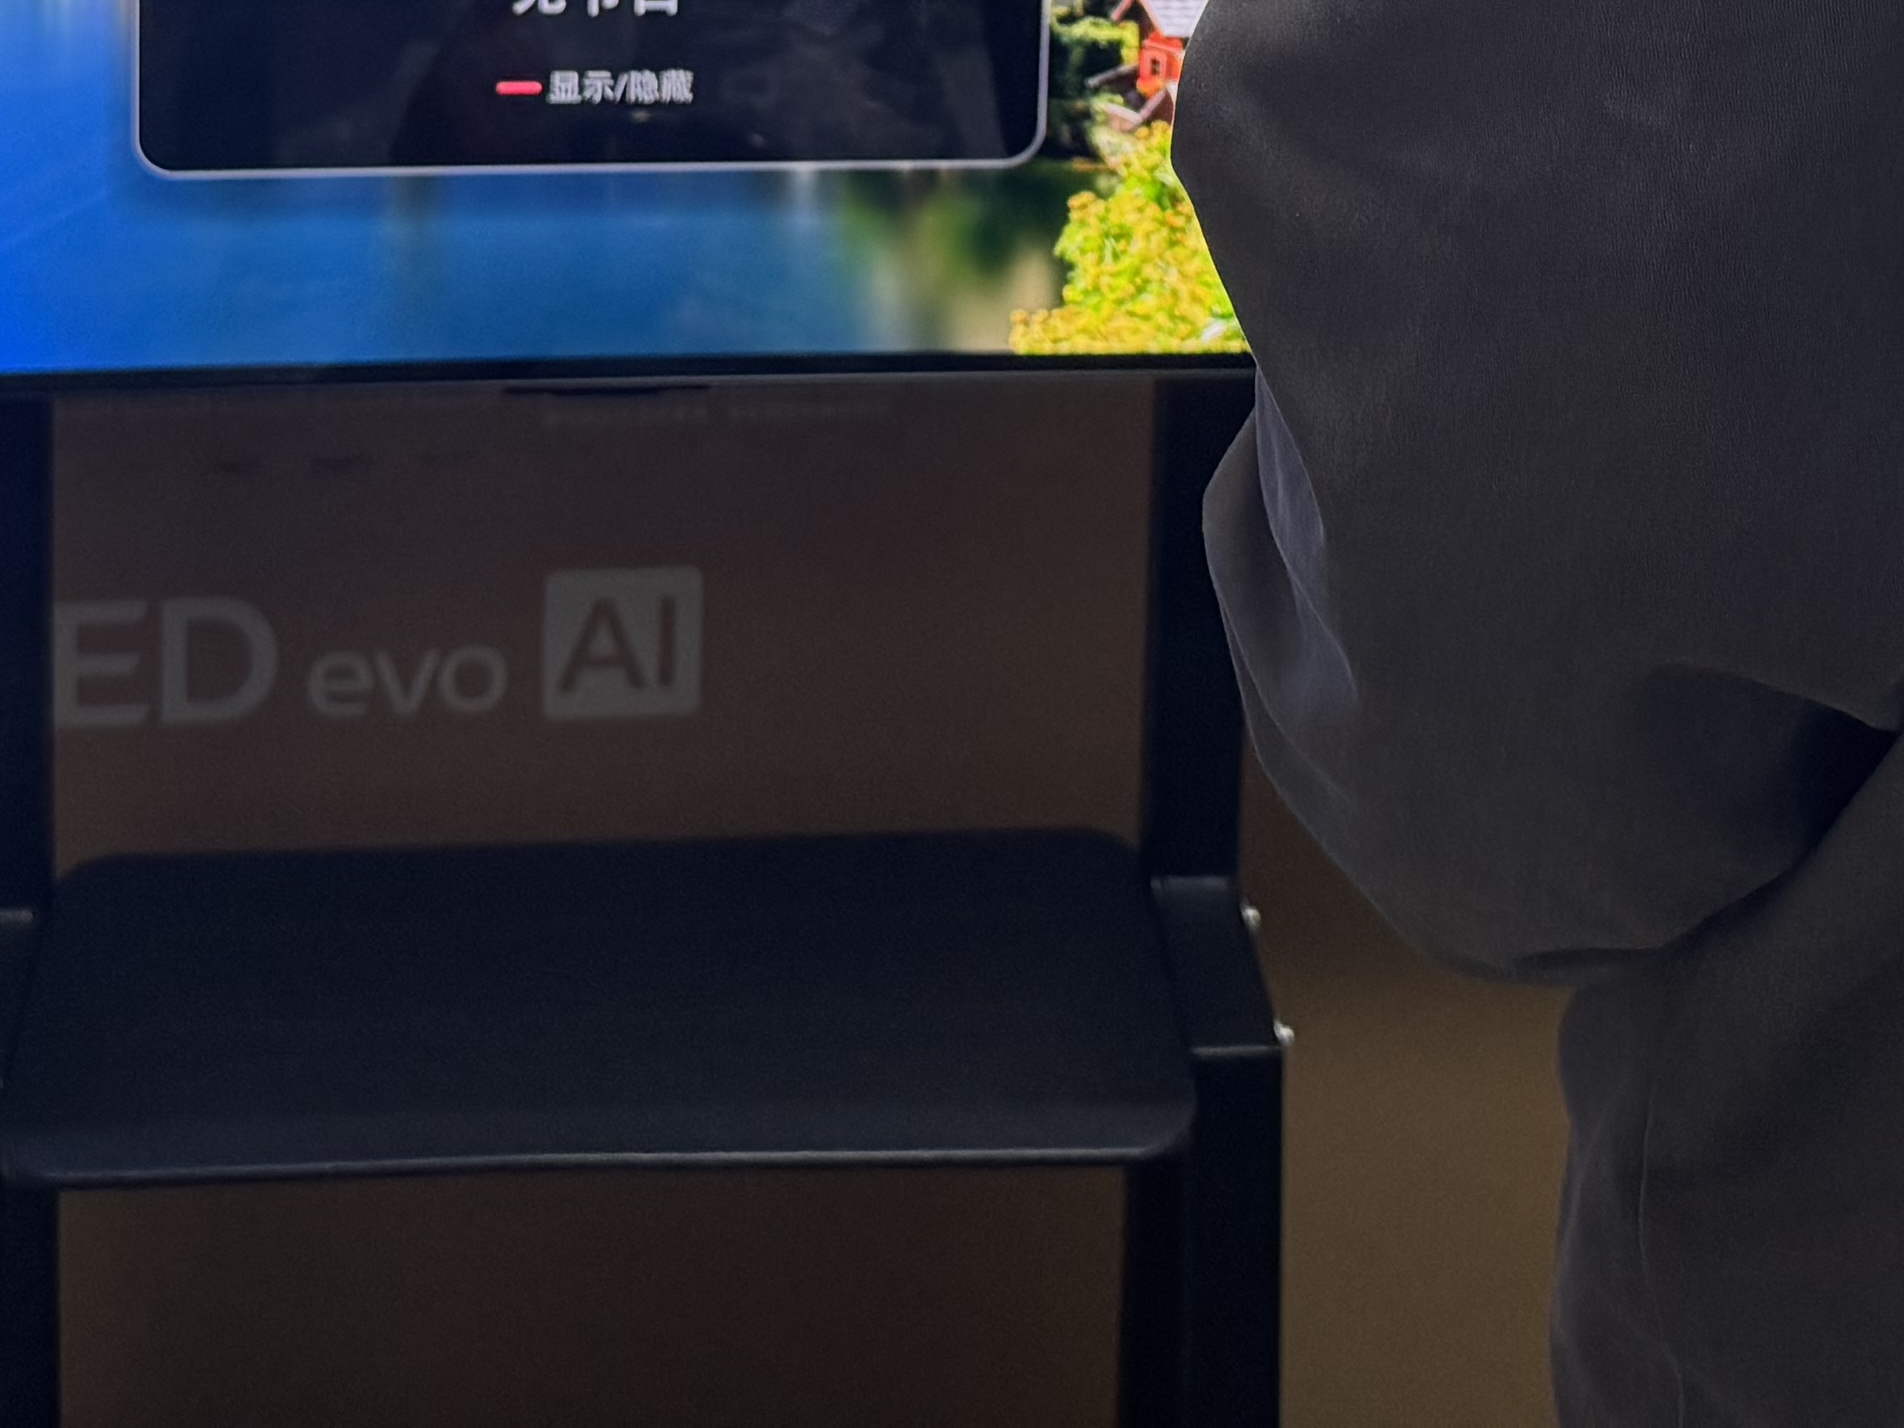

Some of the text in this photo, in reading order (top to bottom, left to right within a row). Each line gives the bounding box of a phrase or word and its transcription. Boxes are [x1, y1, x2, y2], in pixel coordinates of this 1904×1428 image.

[548, 69, 695, 105] 显示/隐藏
[307, 642, 509, 722] evo
[554, 590, 683, 700] AI
